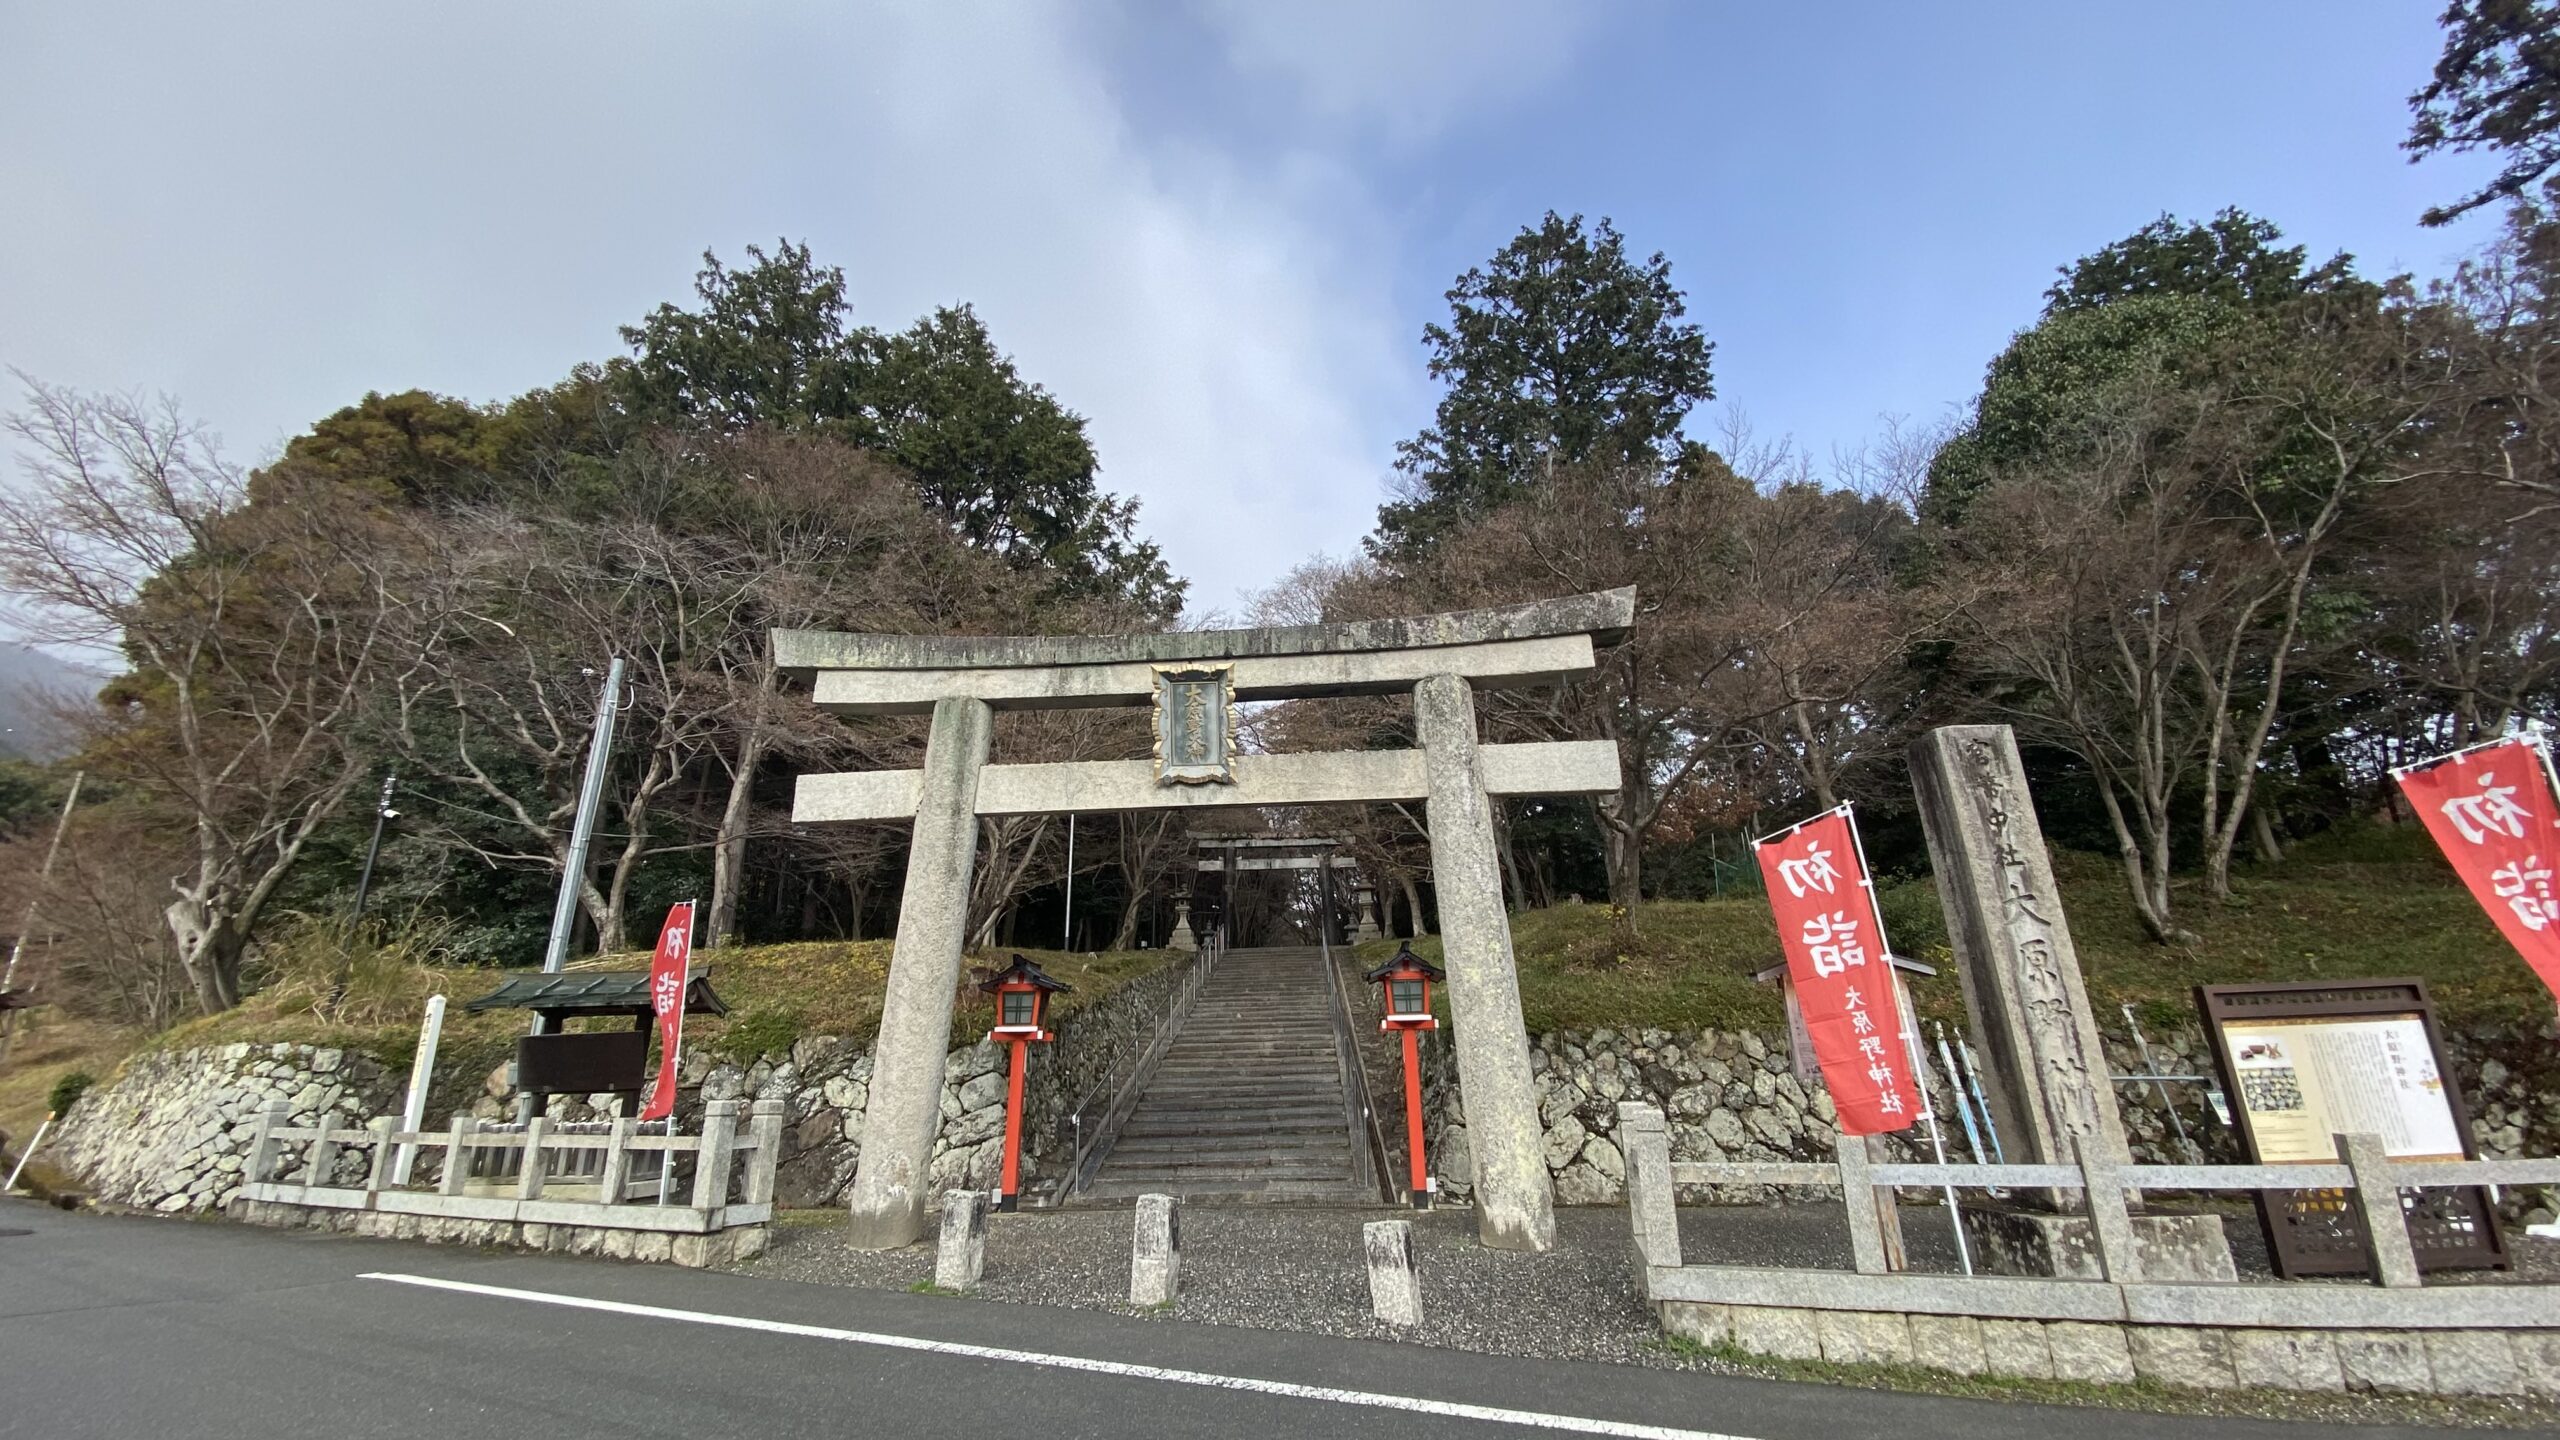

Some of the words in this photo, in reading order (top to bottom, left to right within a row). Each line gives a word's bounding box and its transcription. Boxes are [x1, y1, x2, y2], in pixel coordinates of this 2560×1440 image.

[1965, 738, 2090, 1135] 官幣中社大原野神
